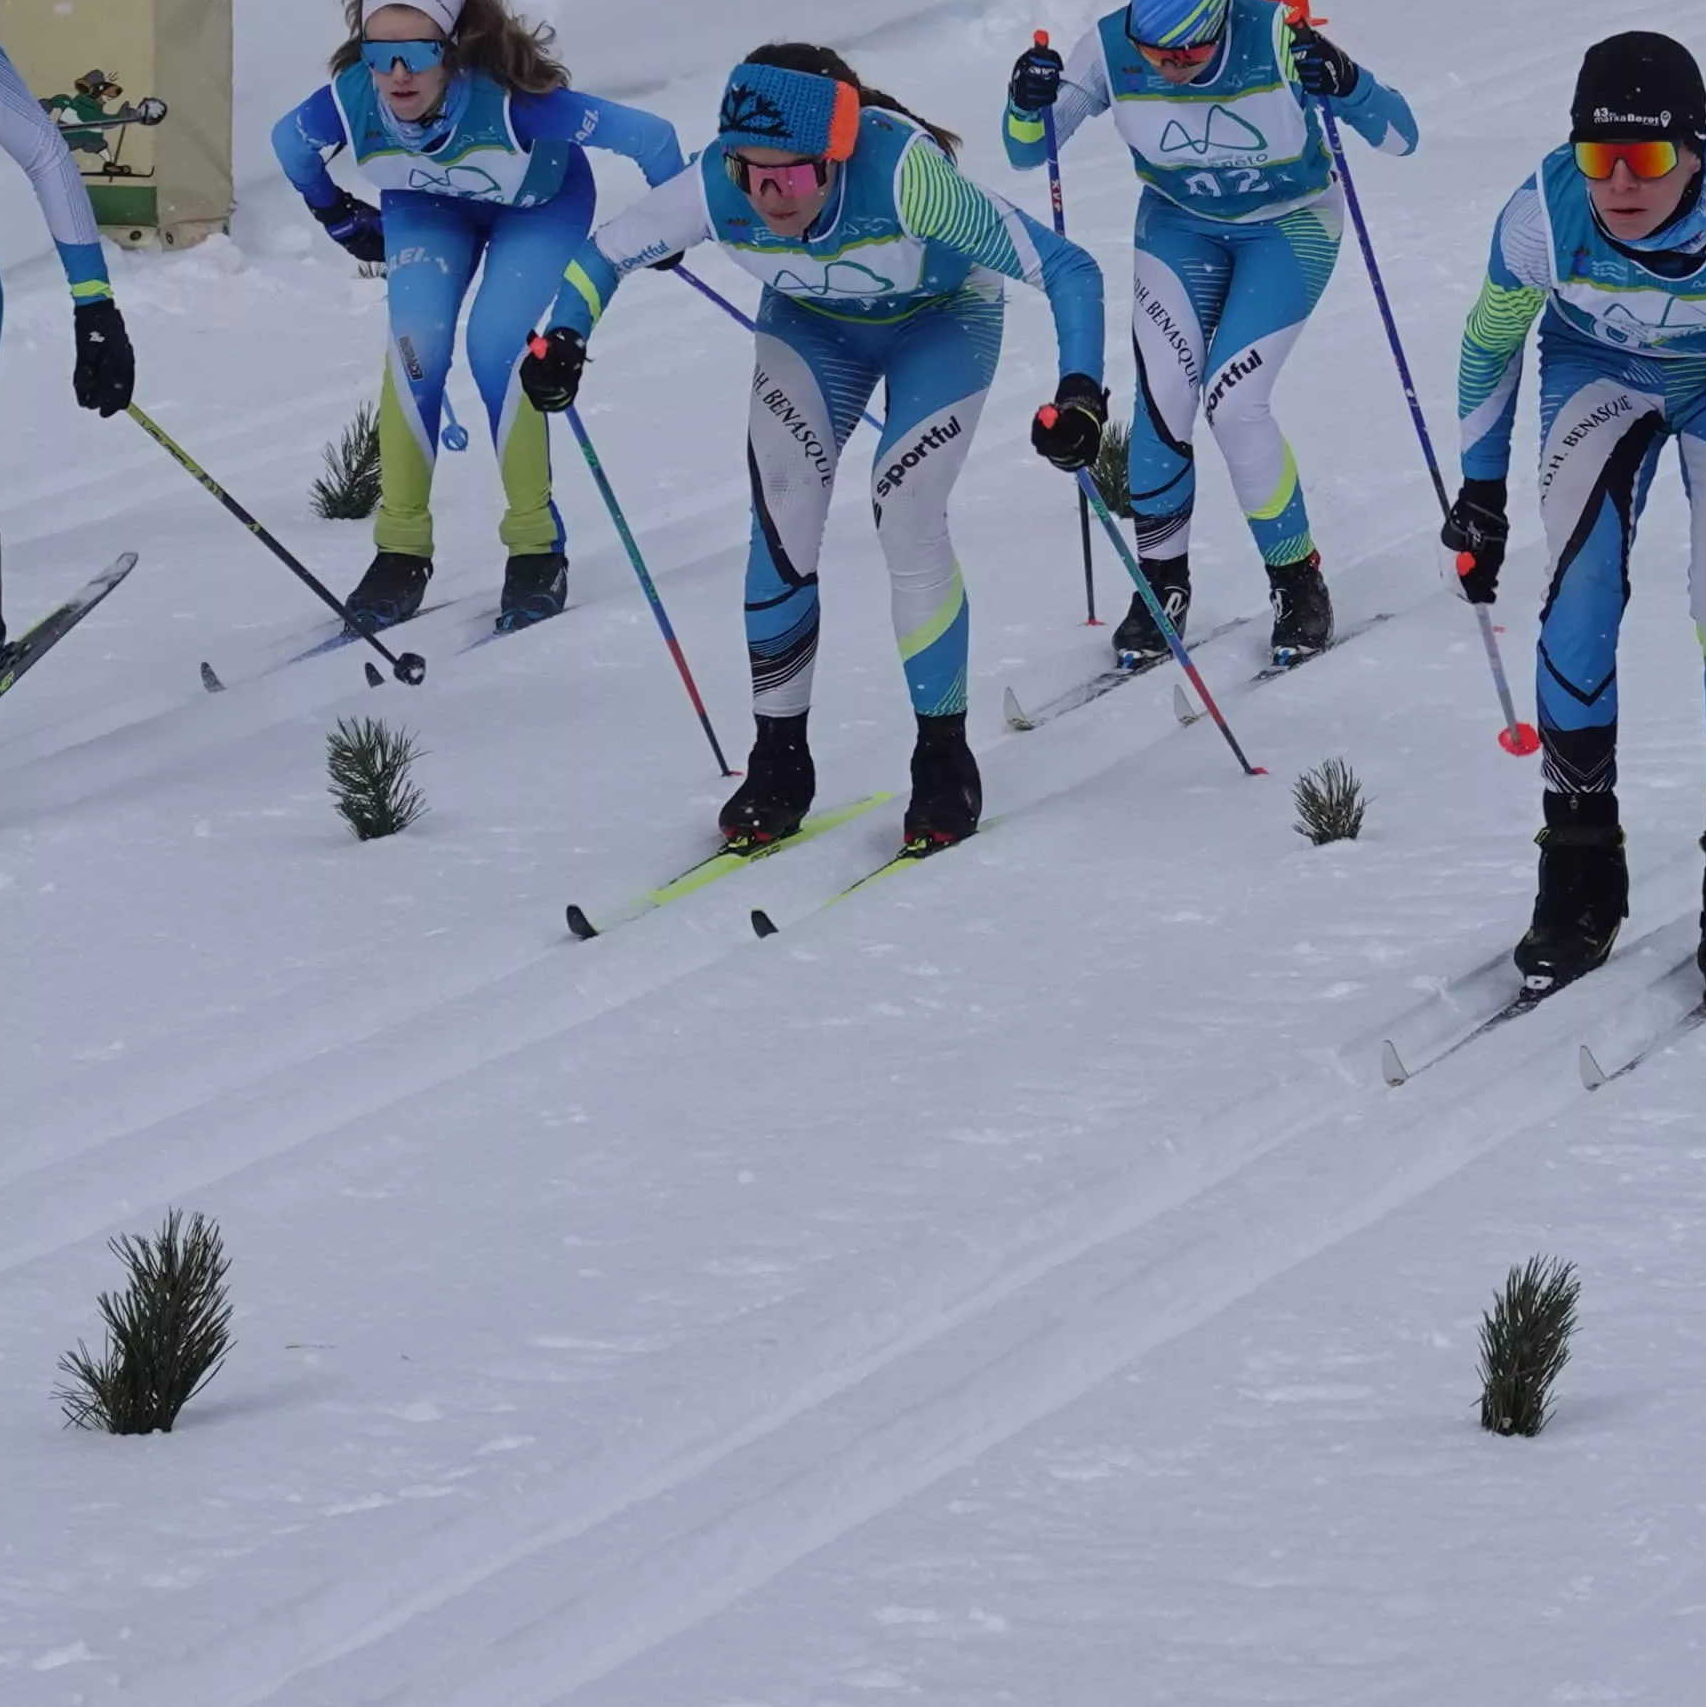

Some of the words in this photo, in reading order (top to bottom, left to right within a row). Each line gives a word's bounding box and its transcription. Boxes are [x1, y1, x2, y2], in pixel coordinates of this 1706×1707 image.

[1145, 299, 1200, 389] BENASQUE
[762, 388, 834, 489] BENASQUE
[875, 414, 963, 498] sportful
[1562, 394, 1634, 448] BENASQUE
